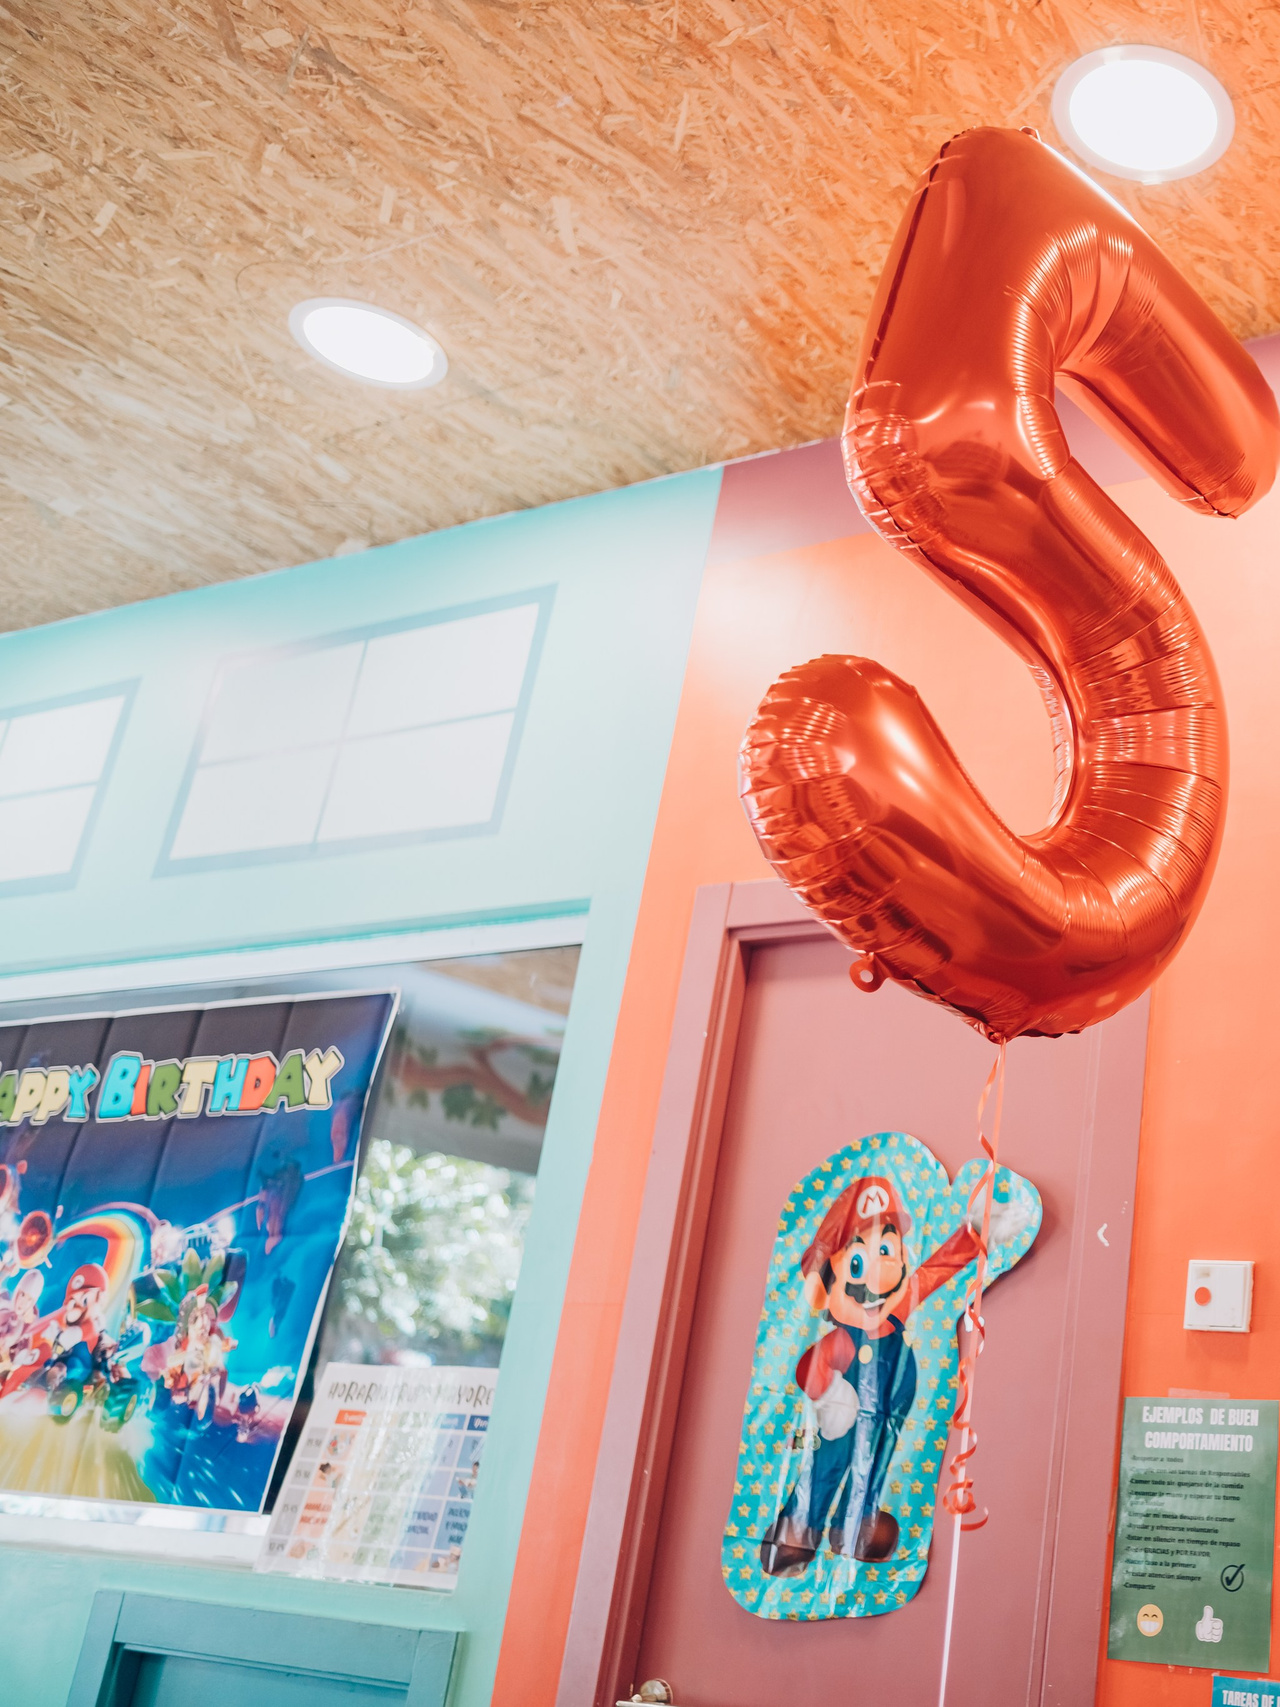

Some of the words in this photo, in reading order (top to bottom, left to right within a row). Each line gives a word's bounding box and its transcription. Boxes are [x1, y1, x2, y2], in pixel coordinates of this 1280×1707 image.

[0, 1062, 100, 1127] APPY
[96, 1045, 345, 1123] BIRTHDAY
[862, 1191, 885, 1214] M
[1142, 1406, 1204, 1425] EJEMPLOS
[1210, 1408, 1225, 1425] DE
[1228, 1409, 1259, 1426] BUEN
[1144, 1431, 1254, 1452] COMPORTAMIENTO
[1222, 1690, 1259, 1707] TAREAS
[1261, 1694, 1274, 1707] DE
